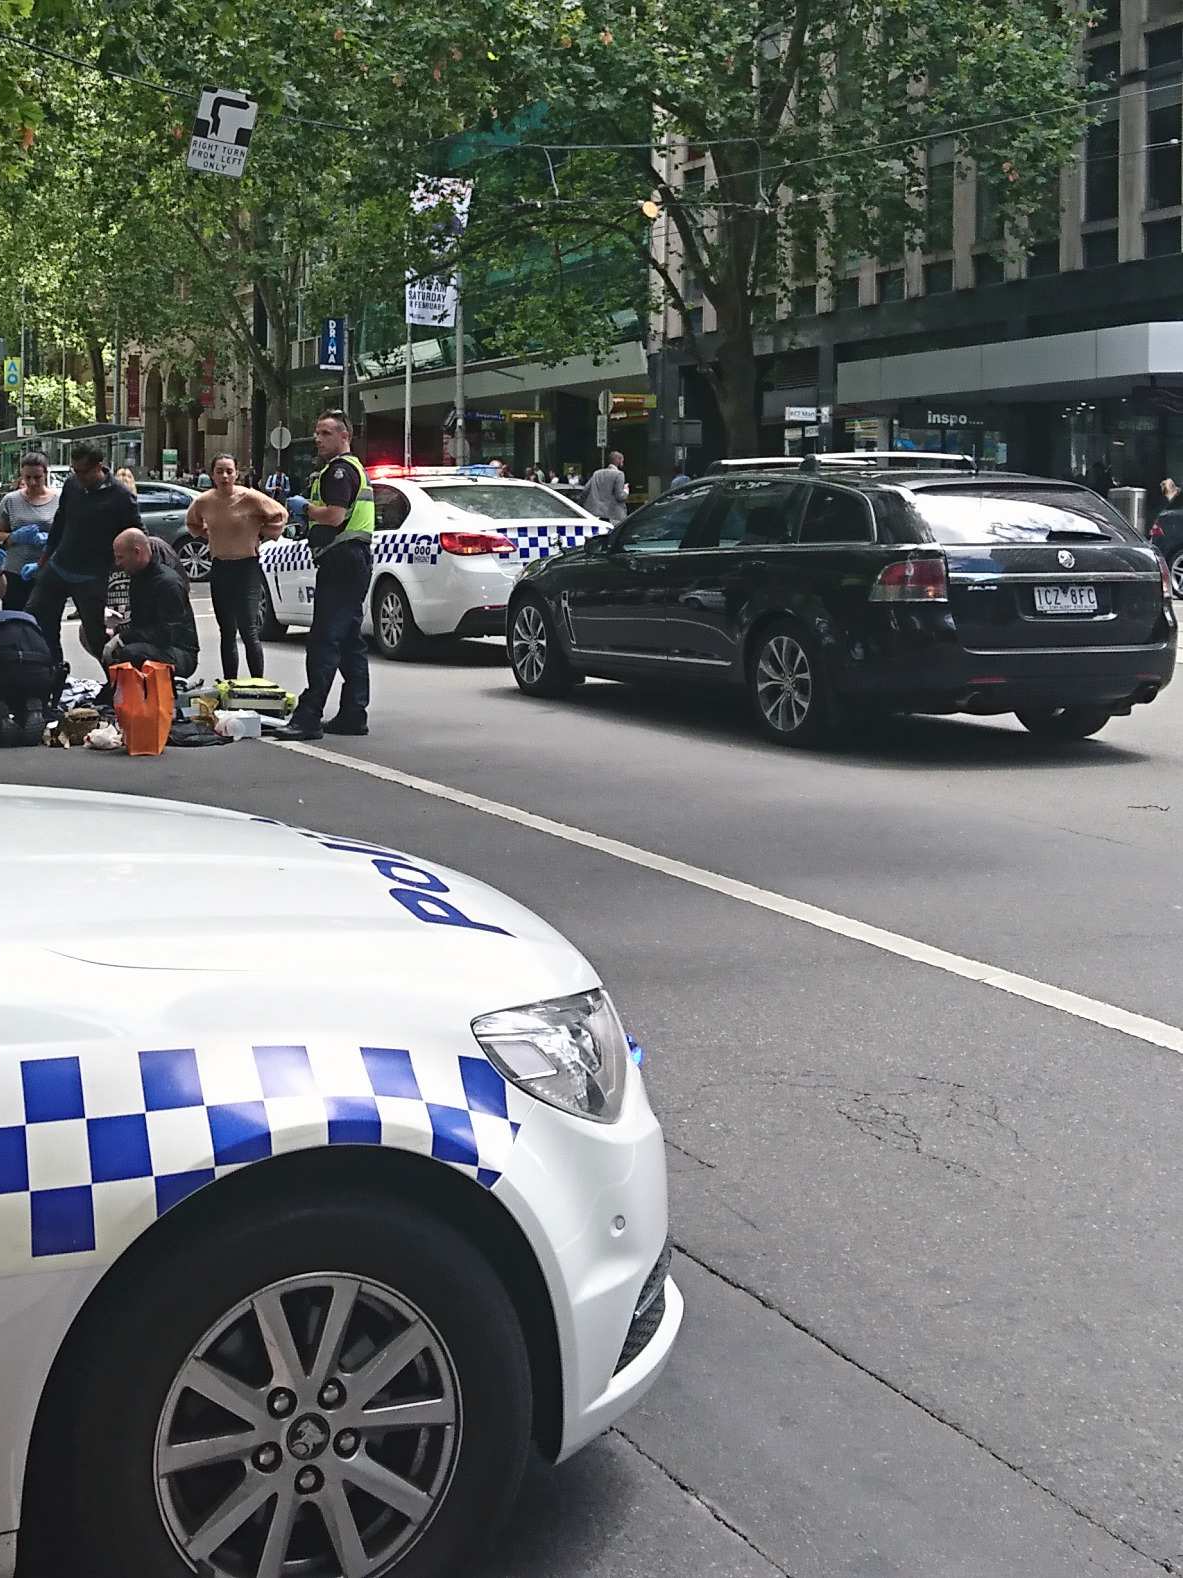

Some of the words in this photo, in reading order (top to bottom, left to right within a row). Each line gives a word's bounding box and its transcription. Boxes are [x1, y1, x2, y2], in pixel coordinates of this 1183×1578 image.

[192, 140, 219, 151] RIGHT
[223, 146, 246, 158] TURN
[191, 149, 216, 160] FROM
[221, 155, 243, 166] LEFT
[203, 161, 227, 171] ONLY
[408, 290, 446, 303] SATURDAY
[415, 301, 445, 311] FEBRUARY
[328, 319, 337, 364] DRAMA
[414, 546, 431, 556] 000
